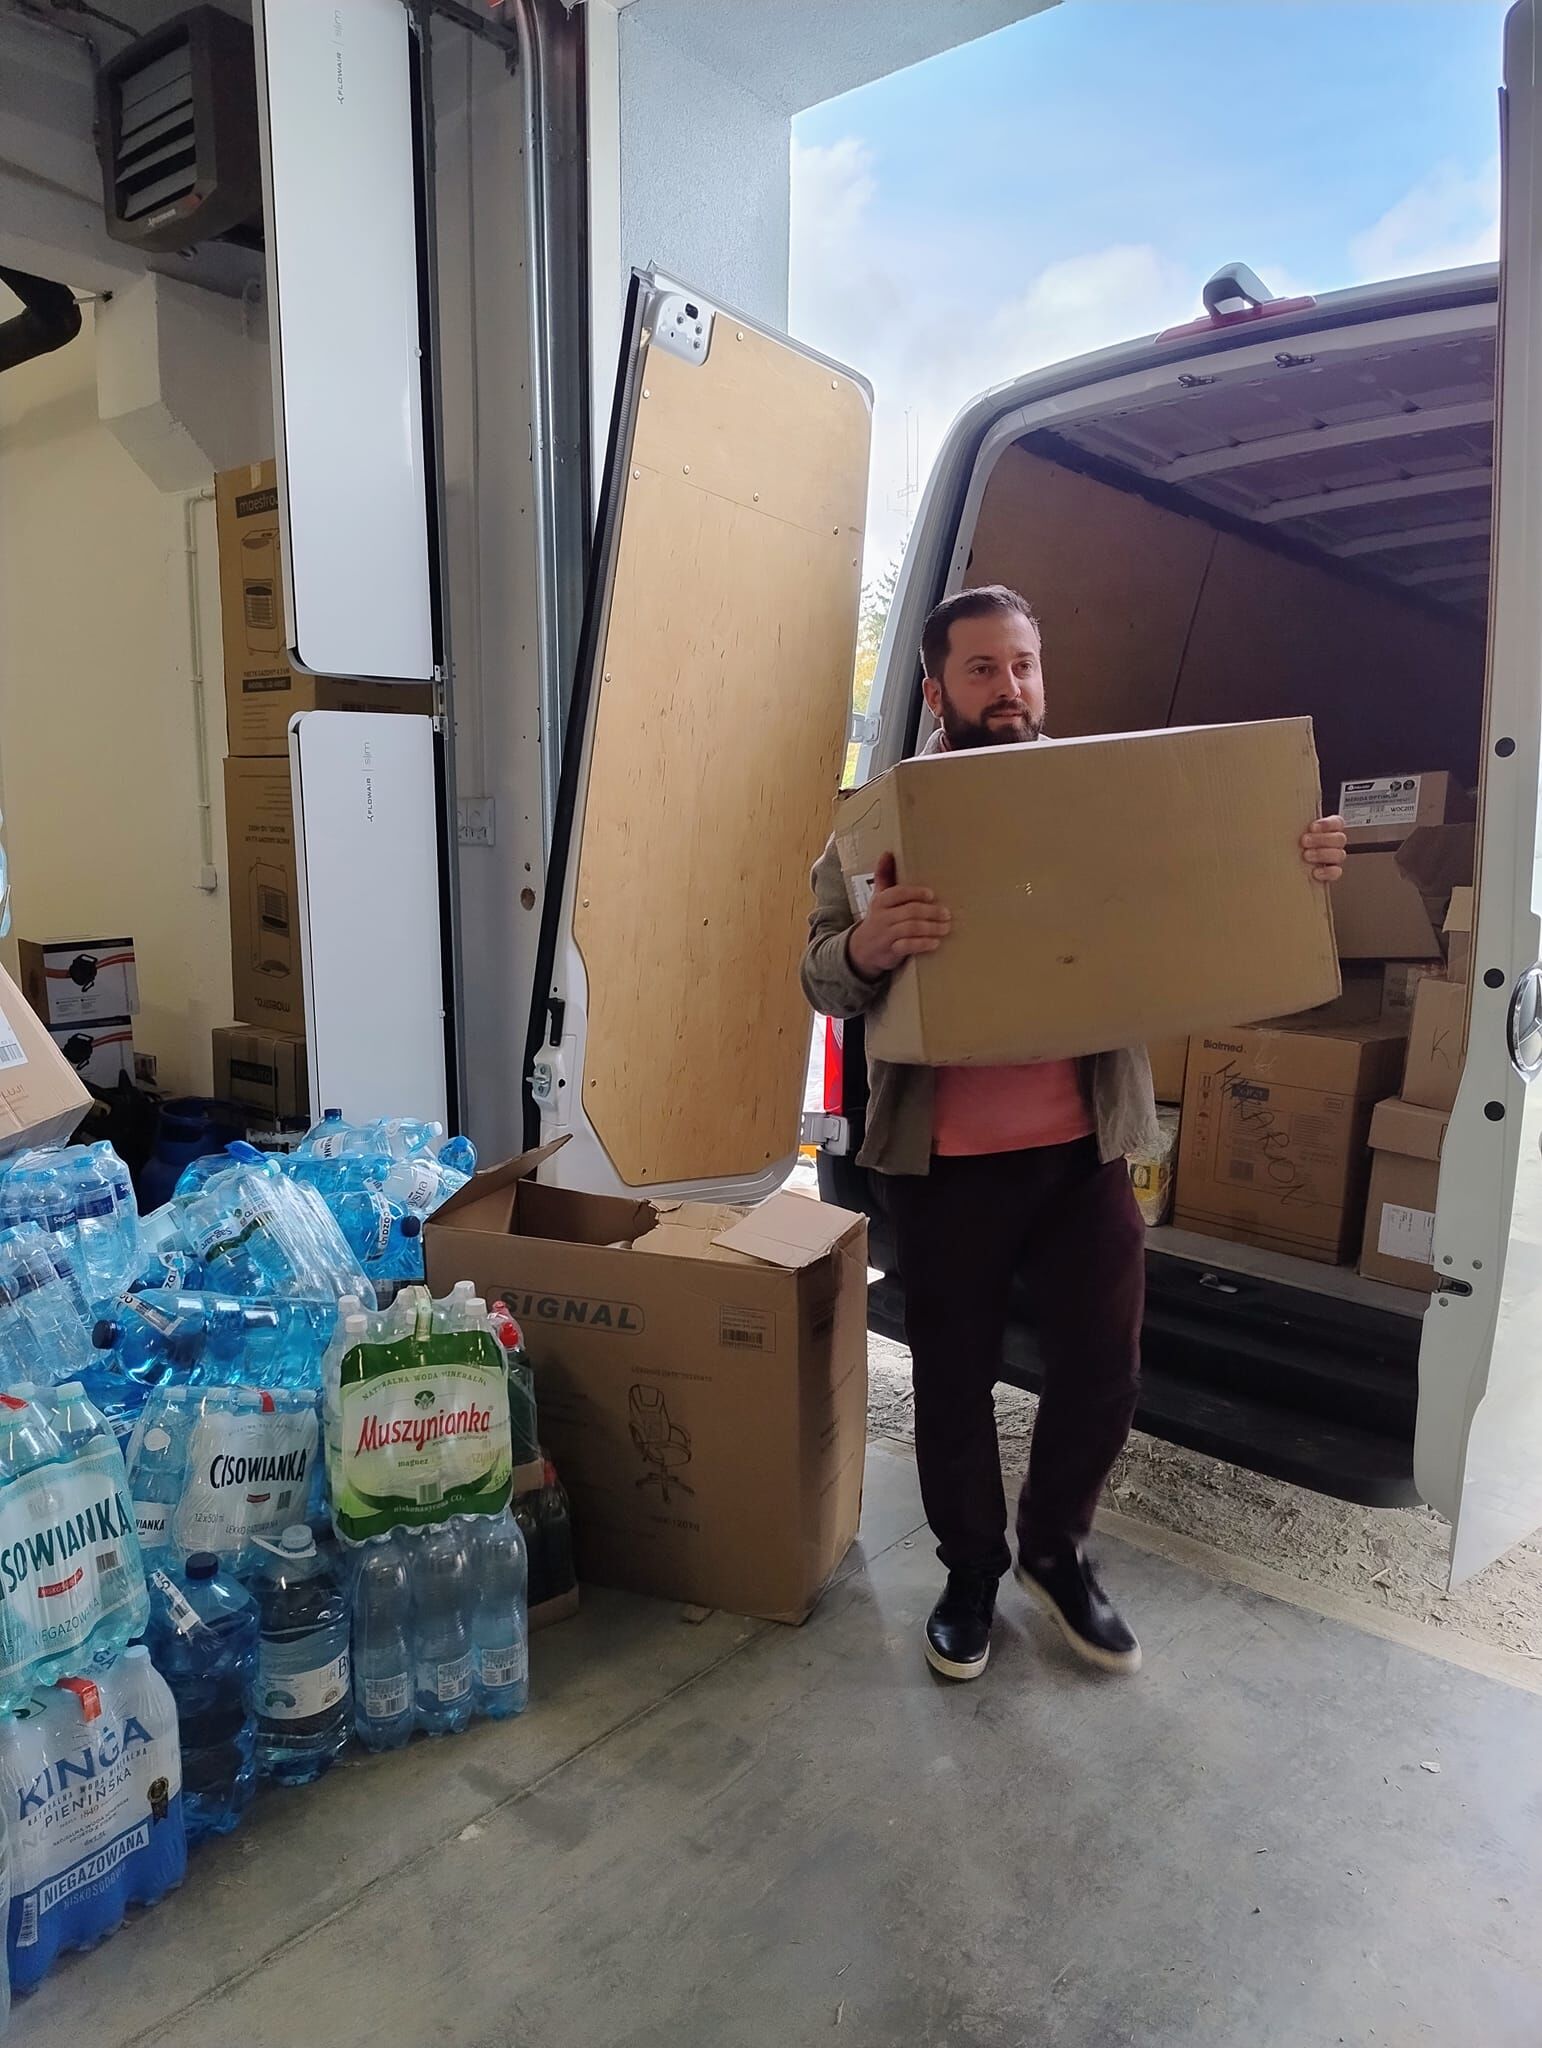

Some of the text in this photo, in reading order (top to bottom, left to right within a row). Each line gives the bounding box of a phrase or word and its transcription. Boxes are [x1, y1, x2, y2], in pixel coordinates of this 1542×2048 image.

[501, 1291, 637, 1331] SIGNAL
[354, 1402, 491, 1459] Muszynianka
[210, 1448, 308, 1490] CISOWIANKA
[17, 1716, 154, 1821] KINGA
[43, 1829, 146, 1910] NIEGAZOWANA
